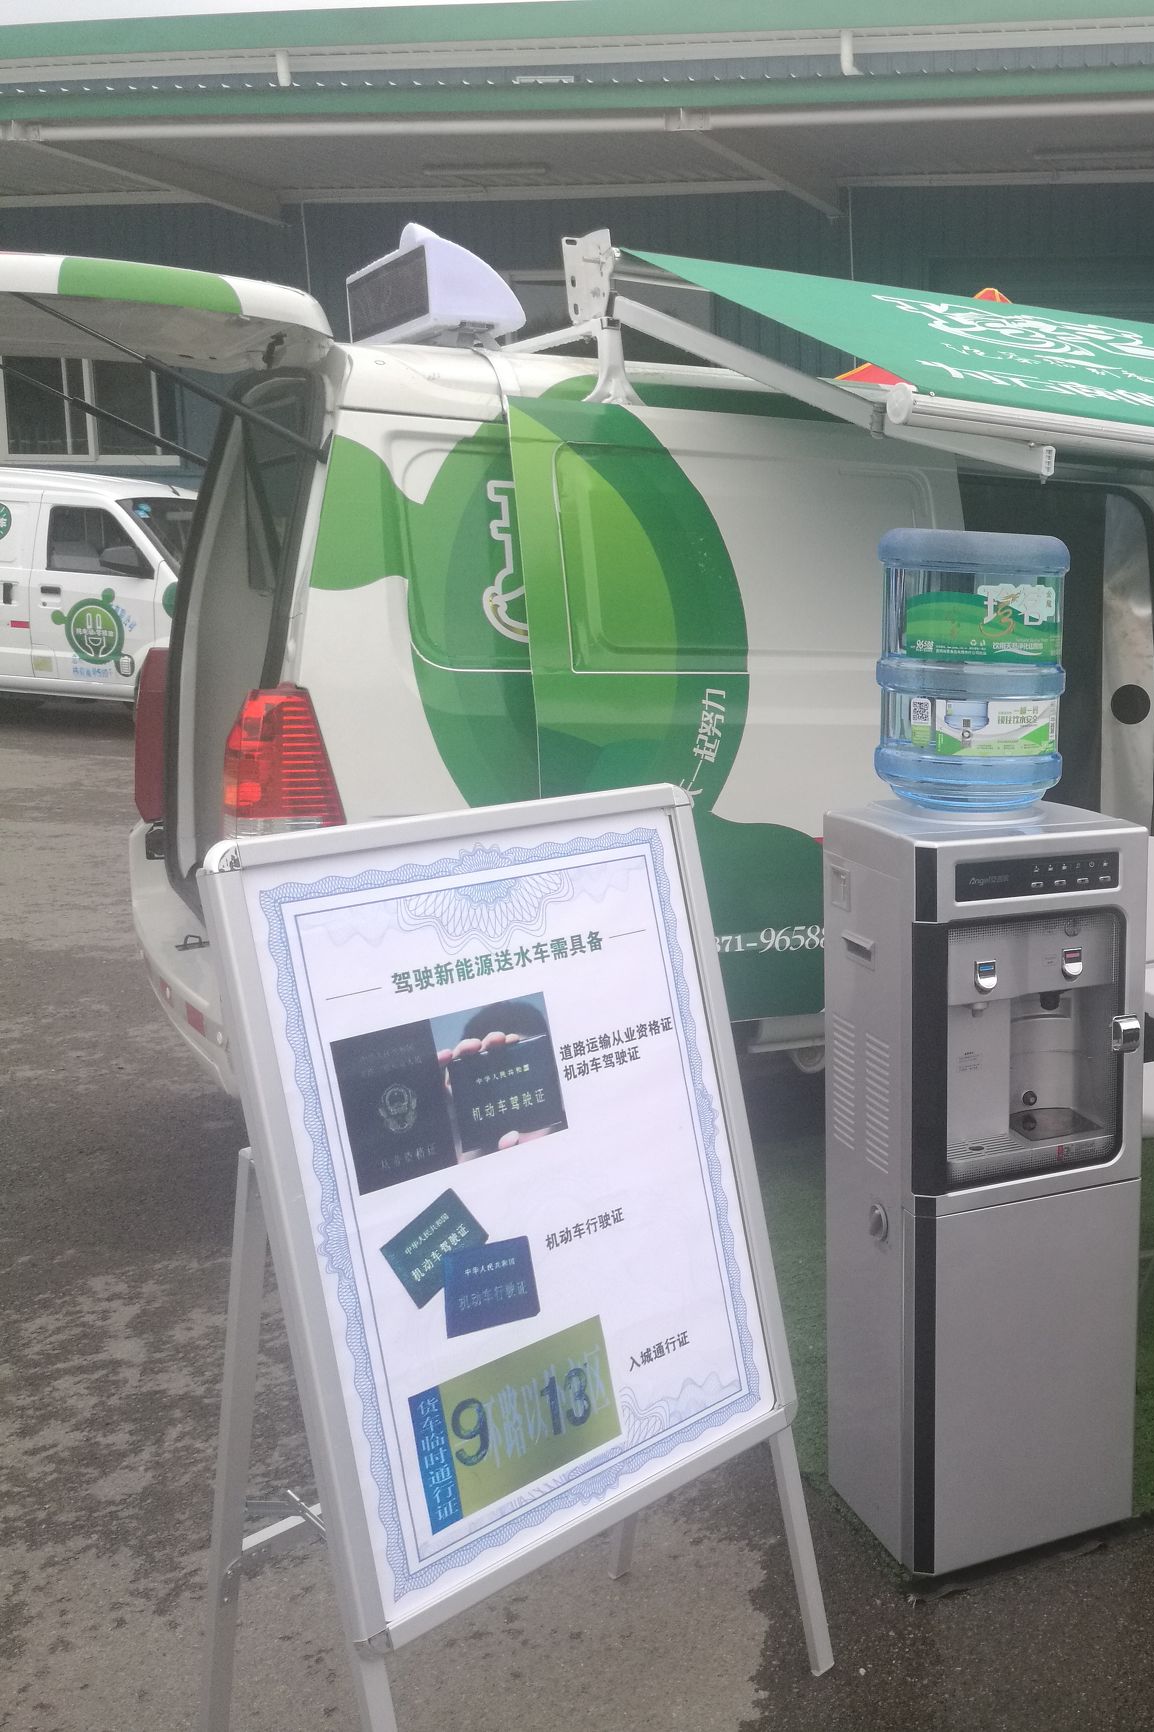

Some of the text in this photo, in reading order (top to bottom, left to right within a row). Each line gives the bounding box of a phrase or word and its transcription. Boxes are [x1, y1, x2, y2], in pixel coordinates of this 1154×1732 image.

[391, 930, 603, 994] 驾驶新能源送水车需具备
[560, 1016, 673, 1061] 道路运输从业资格证
[563, 1046, 641, 1081] 机动车驾驶证
[472, 1088, 545, 1121] 机动车驾驶证
[405, 1212, 450, 1255] 中华人民共和国
[545, 1207, 625, 1250] 机动车行驶证
[411, 1223, 470, 1283] 机动车驾驶证
[464, 1257, 516, 1277] 中华人民共和国
[458, 1281, 528, 1311] 机动车行驶证
[629, 1331, 690, 1372] 入城通行证
[451, 1367, 592, 1466] 9 13
[418, 1397, 459, 1521] 货车临时通行证
